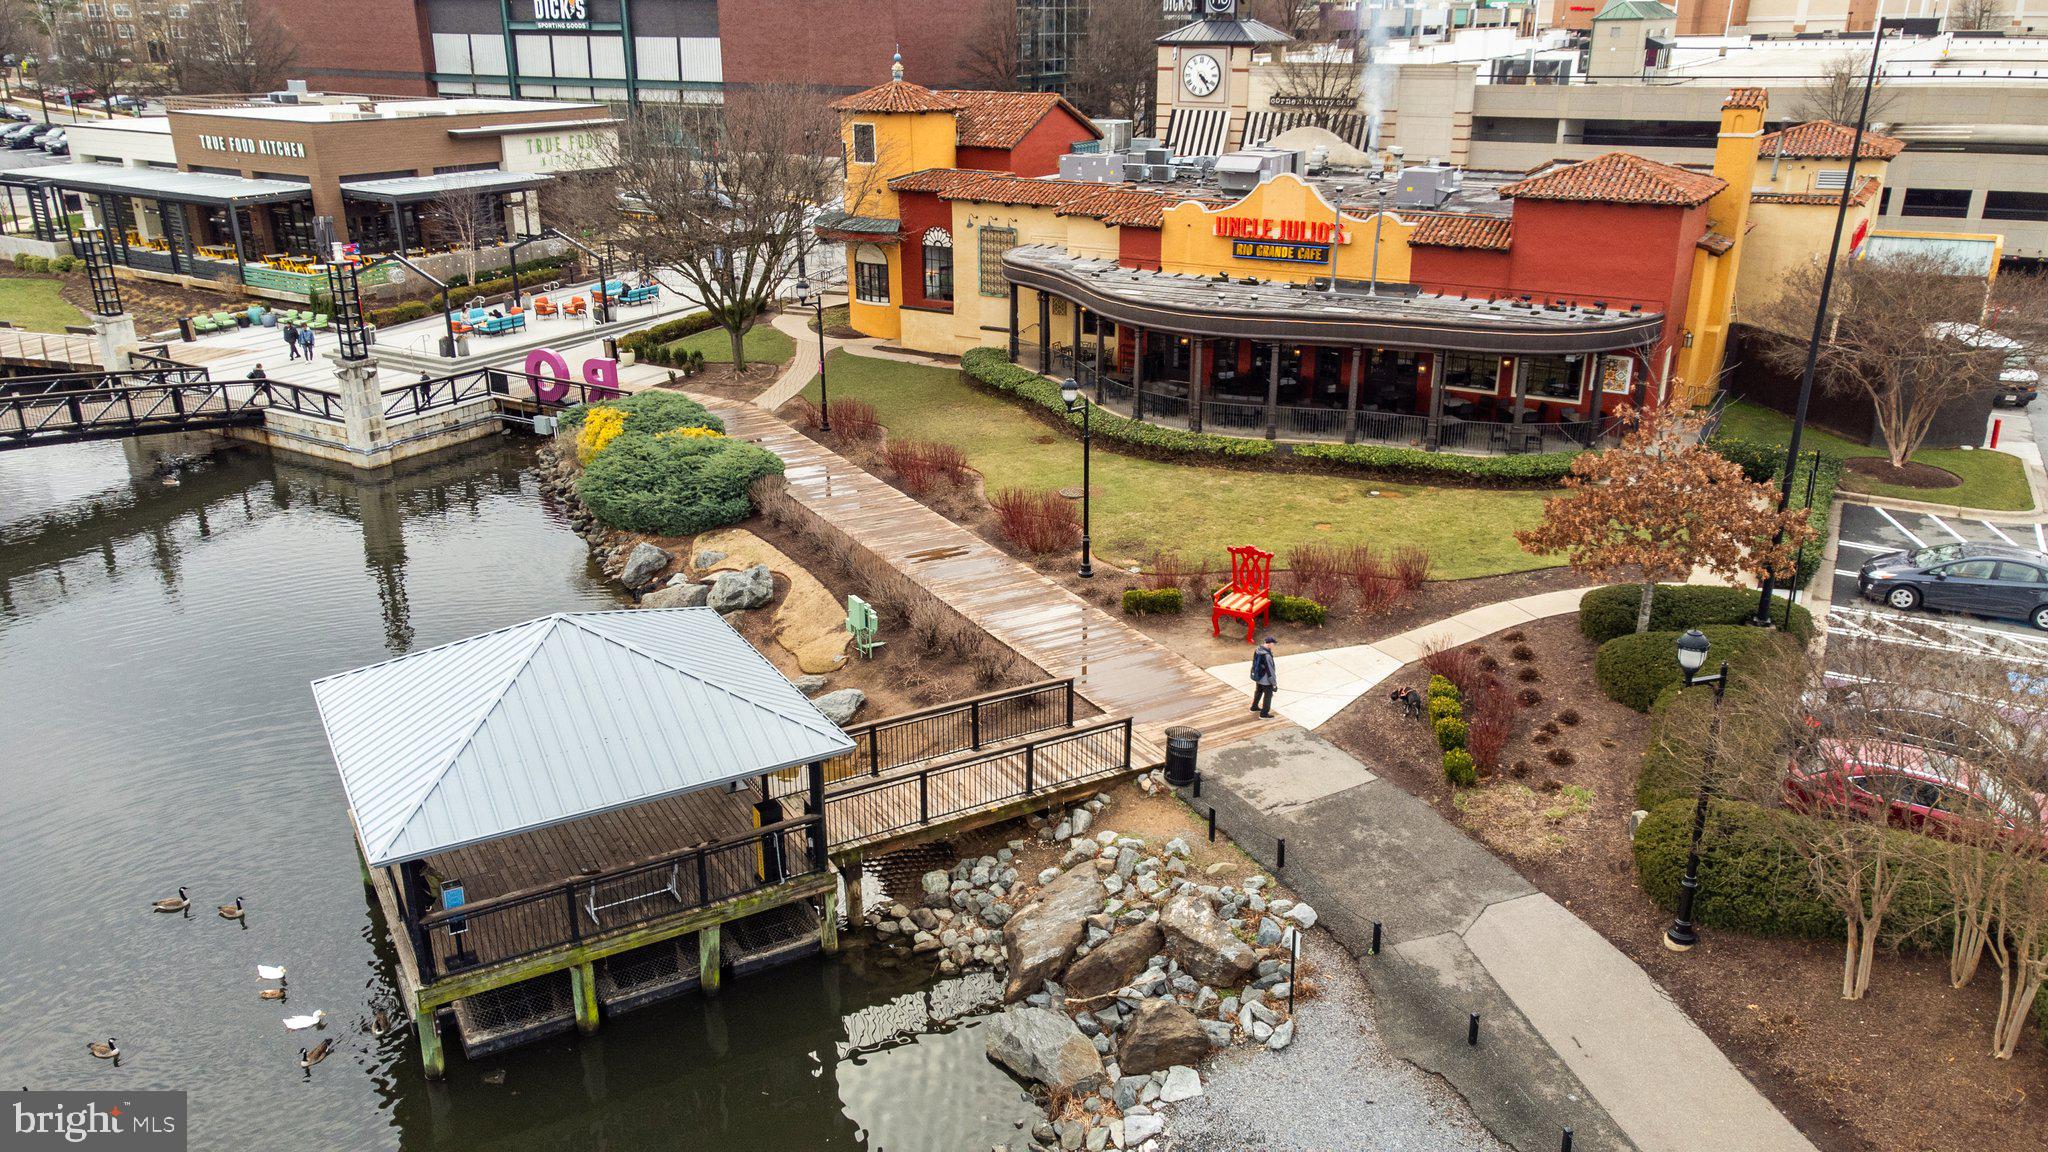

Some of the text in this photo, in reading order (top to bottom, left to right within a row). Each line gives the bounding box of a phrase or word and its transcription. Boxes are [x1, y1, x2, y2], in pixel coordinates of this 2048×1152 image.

[534, 0, 586, 20] DICK'S
[199, 135, 305, 158] TRUE FOOD KITCHEN
[527, 136, 561, 154] TRUE
[1215, 216, 1345, 244] UNCLE JULIO'S
[1236, 243, 1323, 261] RIO GRANDE CAFE
